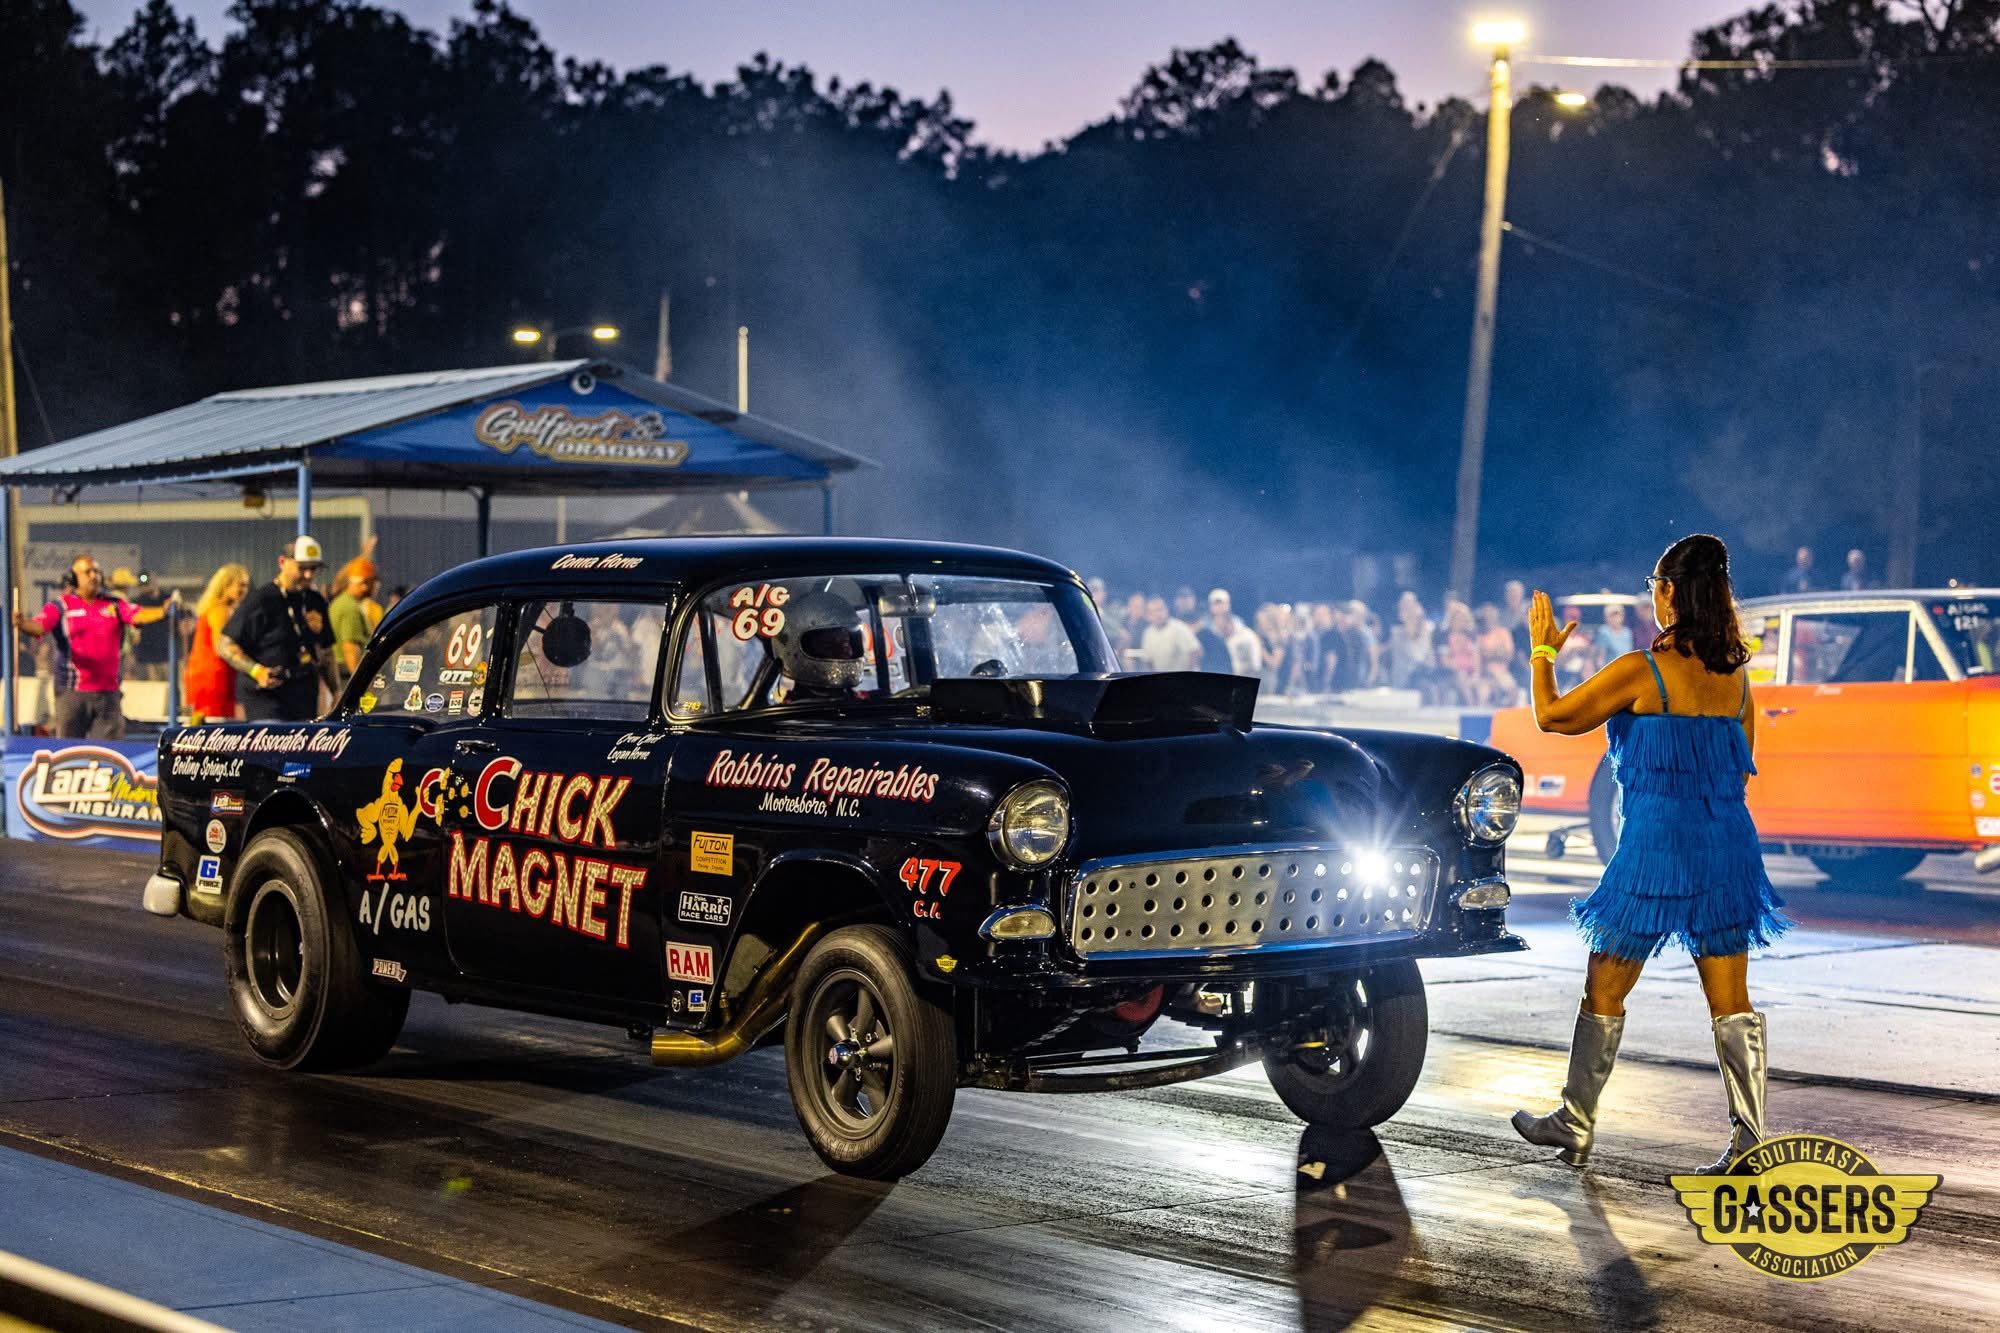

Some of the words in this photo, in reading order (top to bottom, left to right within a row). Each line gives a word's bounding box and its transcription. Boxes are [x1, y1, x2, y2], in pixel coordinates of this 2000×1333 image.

[481, 406, 622, 448] Gulfport
[557, 440, 682, 459] DRAGWAY
[551, 553, 600, 570] Donna
[597, 553, 644, 570] Horne
[729, 582, 790, 608] A/G
[732, 607, 786, 641] 69
[444, 623, 482, 669] 69
[202, 727, 243, 753] Horne
[239, 728, 255, 752] &
[250, 727, 308, 754] Associates
[307, 727, 352, 760] Realty
[33, 760, 113, 803] Laris
[706, 749, 796, 790] Robbins
[802, 757, 940, 805] Repairables
[474, 756, 633, 850] CHICK
[758, 792, 828, 818] Mooresboro,
[836, 798, 861, 818] N.C.
[693, 834, 731, 856] FULTON
[448, 829, 649, 950] MAGNET
[899, 856, 963, 897] 477
[680, 910, 701, 920] RACE
[704, 914, 724, 922] CARS
[682, 894, 730, 915] HARRIS
[669, 948, 711, 978] RAM
